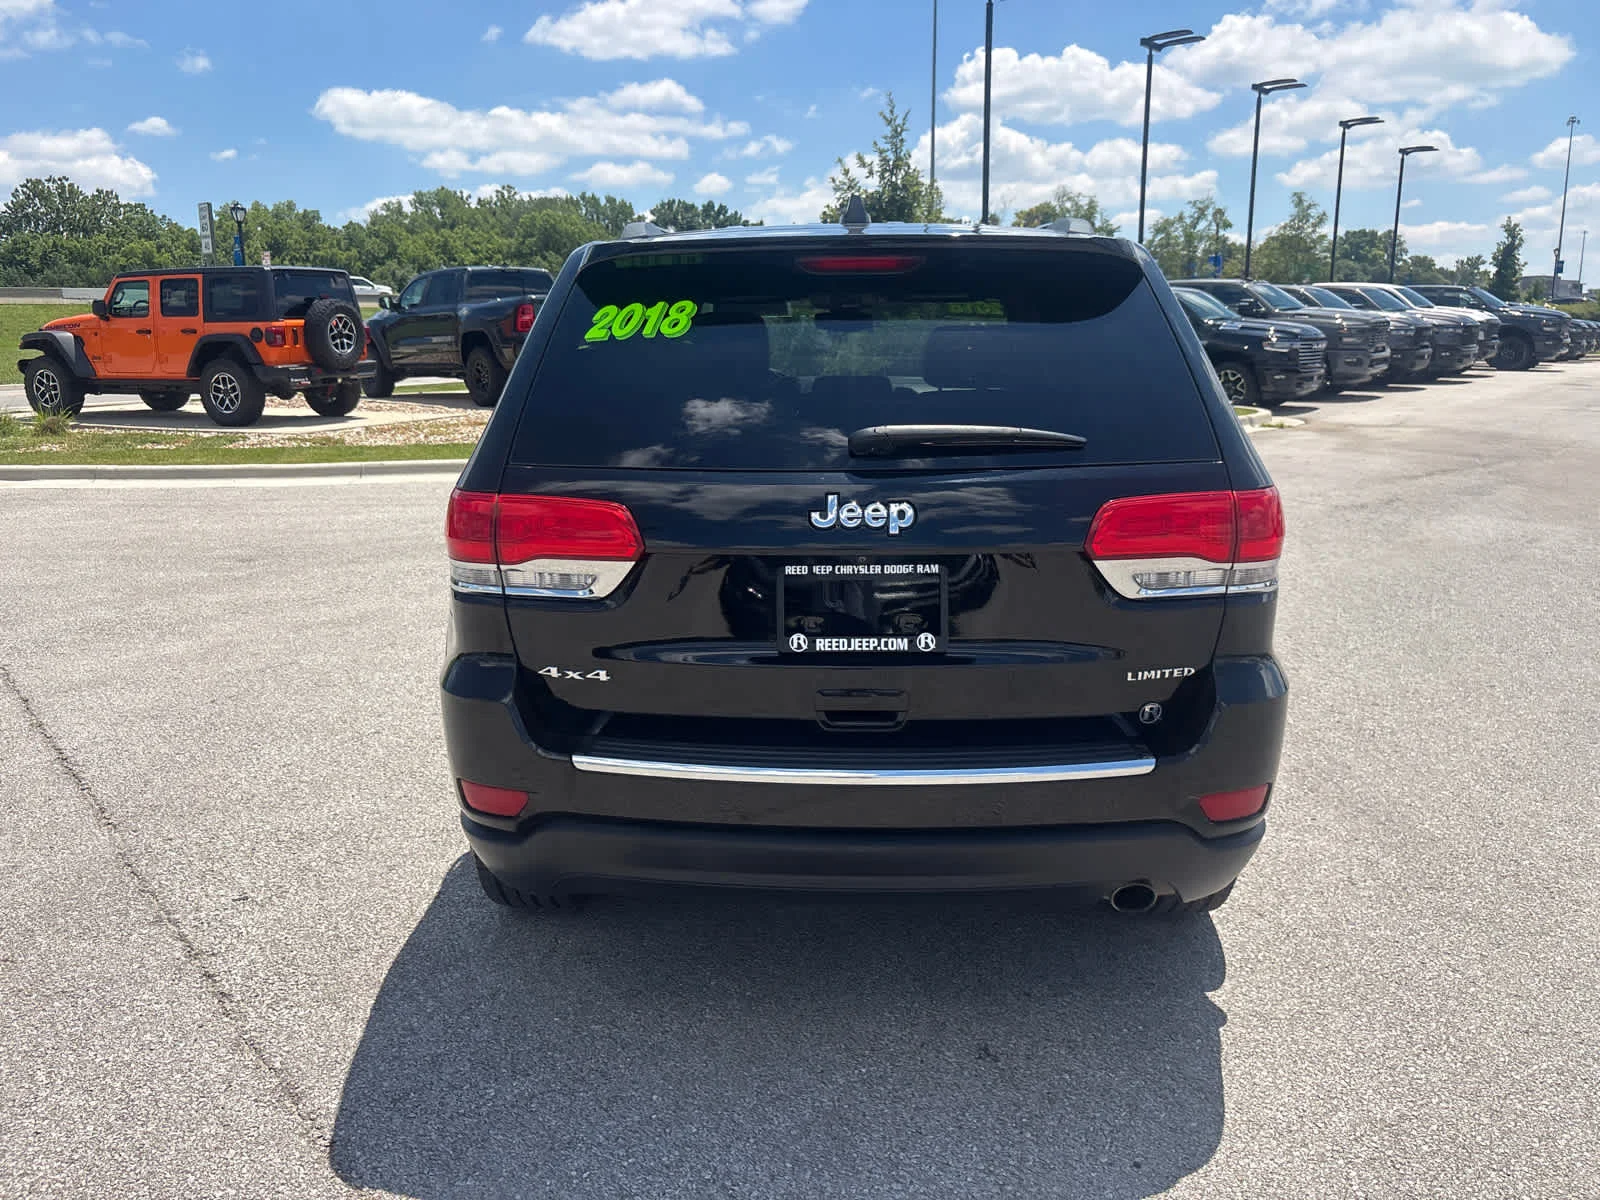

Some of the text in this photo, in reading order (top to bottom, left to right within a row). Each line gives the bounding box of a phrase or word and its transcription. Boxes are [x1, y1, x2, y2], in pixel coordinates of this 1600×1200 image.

[584, 300, 698, 342] 2018
[810, 494, 916, 535] Jeep
[784, 565, 809, 576] REED
[834, 564, 882, 576] CHRYSLER
[883, 564, 915, 575] DODGE
[916, 563, 940, 574] RAM
[815, 637, 909, 651] REEDJEEP.COM
[537, 666, 611, 681] 4x4
[1126, 667, 1196, 682] LIMITED
